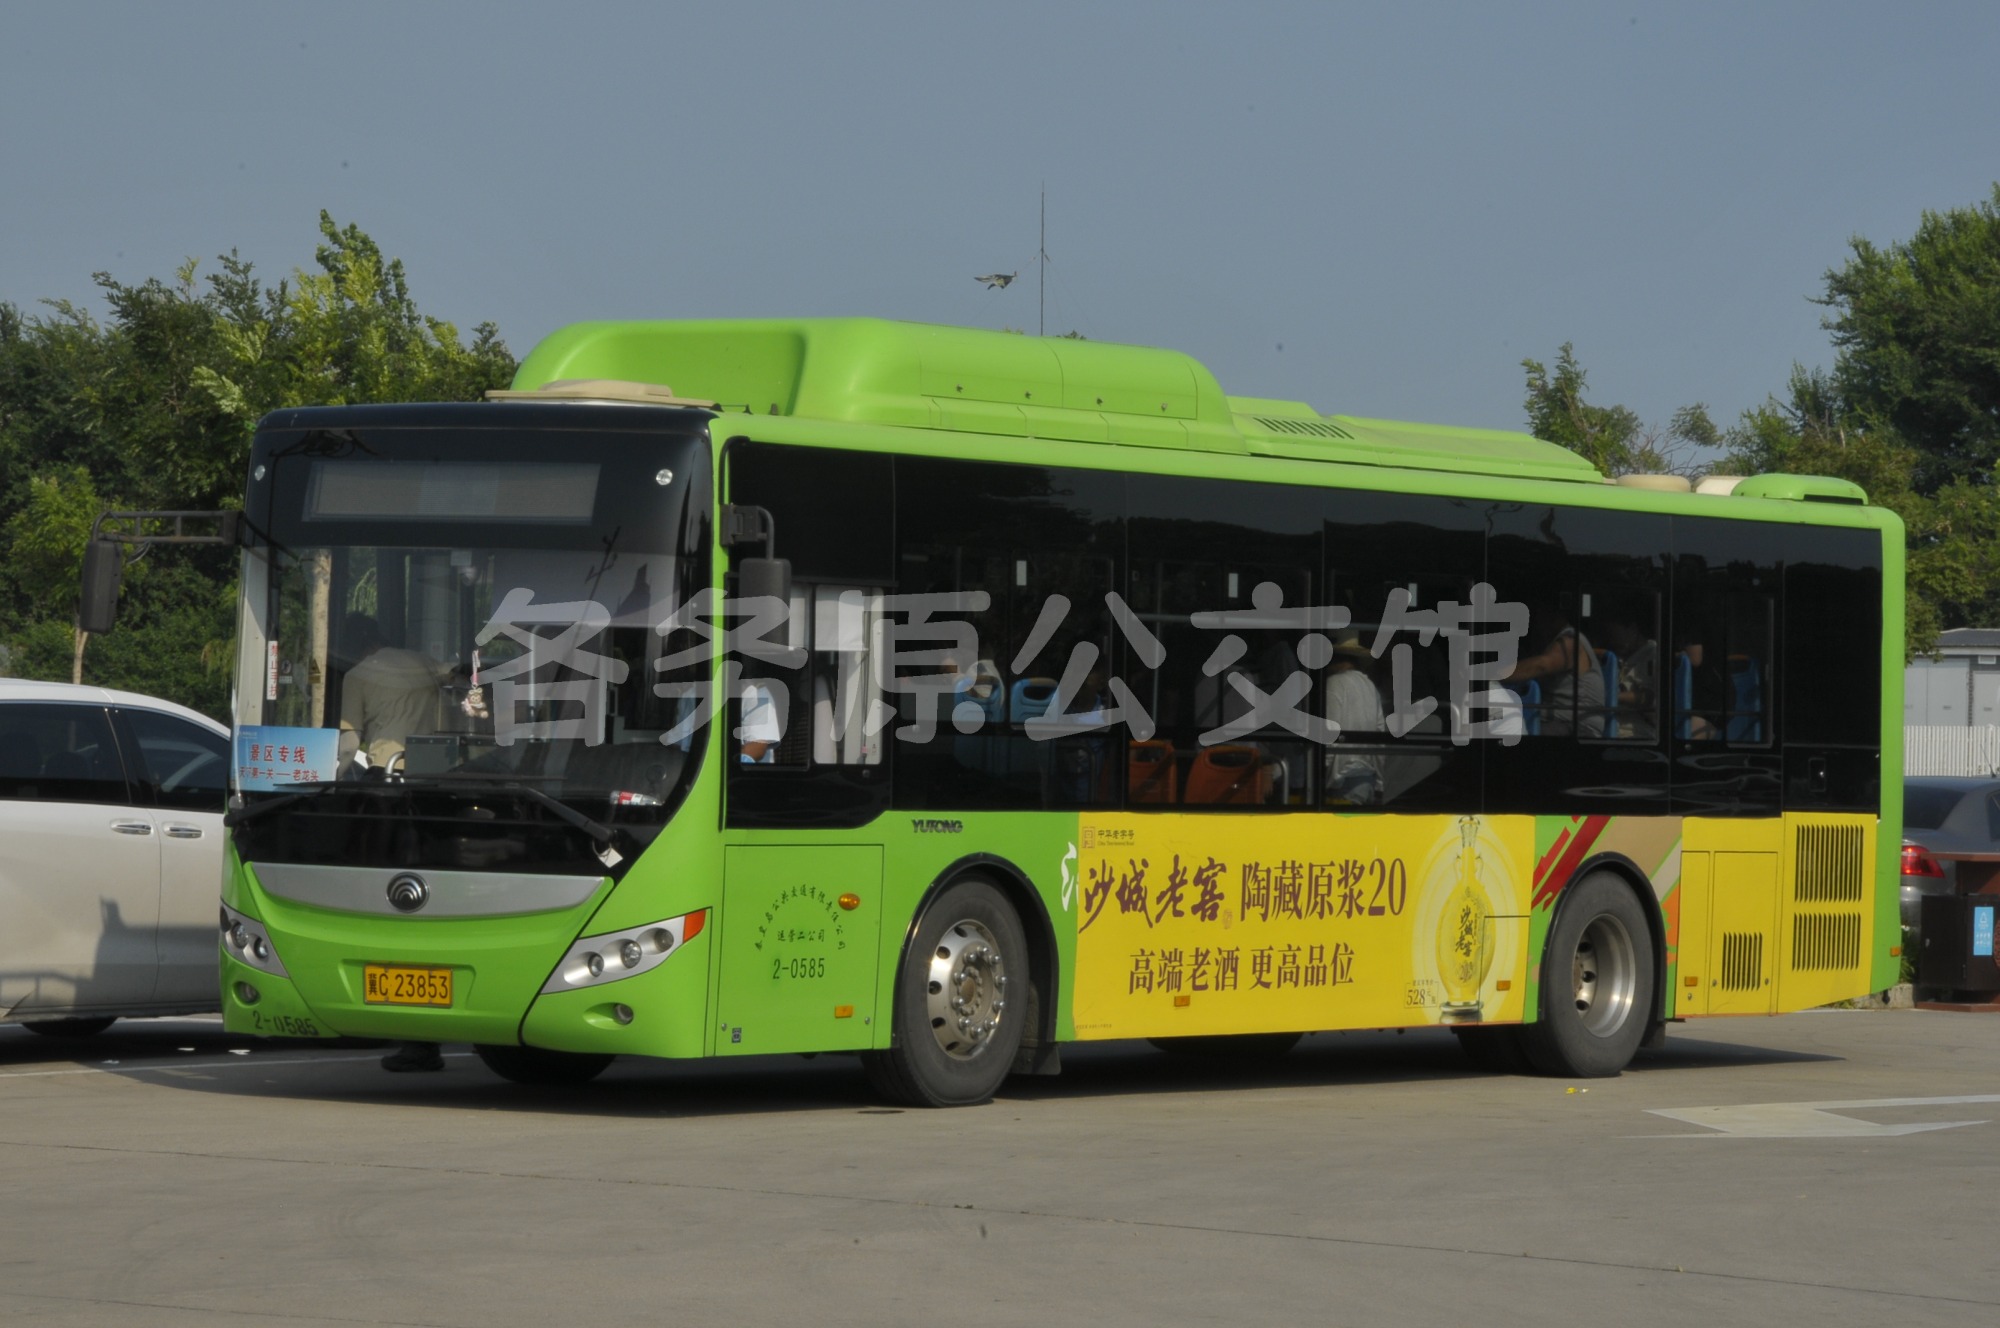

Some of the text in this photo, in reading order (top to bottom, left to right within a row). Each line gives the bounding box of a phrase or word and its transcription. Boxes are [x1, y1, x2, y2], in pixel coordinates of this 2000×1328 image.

[250, 744, 306, 764] 景区专线
[912, 819, 963, 833] YUTONG
[1078, 854, 1406, 934] 沙城老窖 陶藏原浆20
[772, 957, 825, 980] 2-0585
[1128, 941, 1355, 996] 高端老酒 更高品位
[367, 973, 449, 999] 冀C23853
[1406, 989, 1426, 1006] 528
